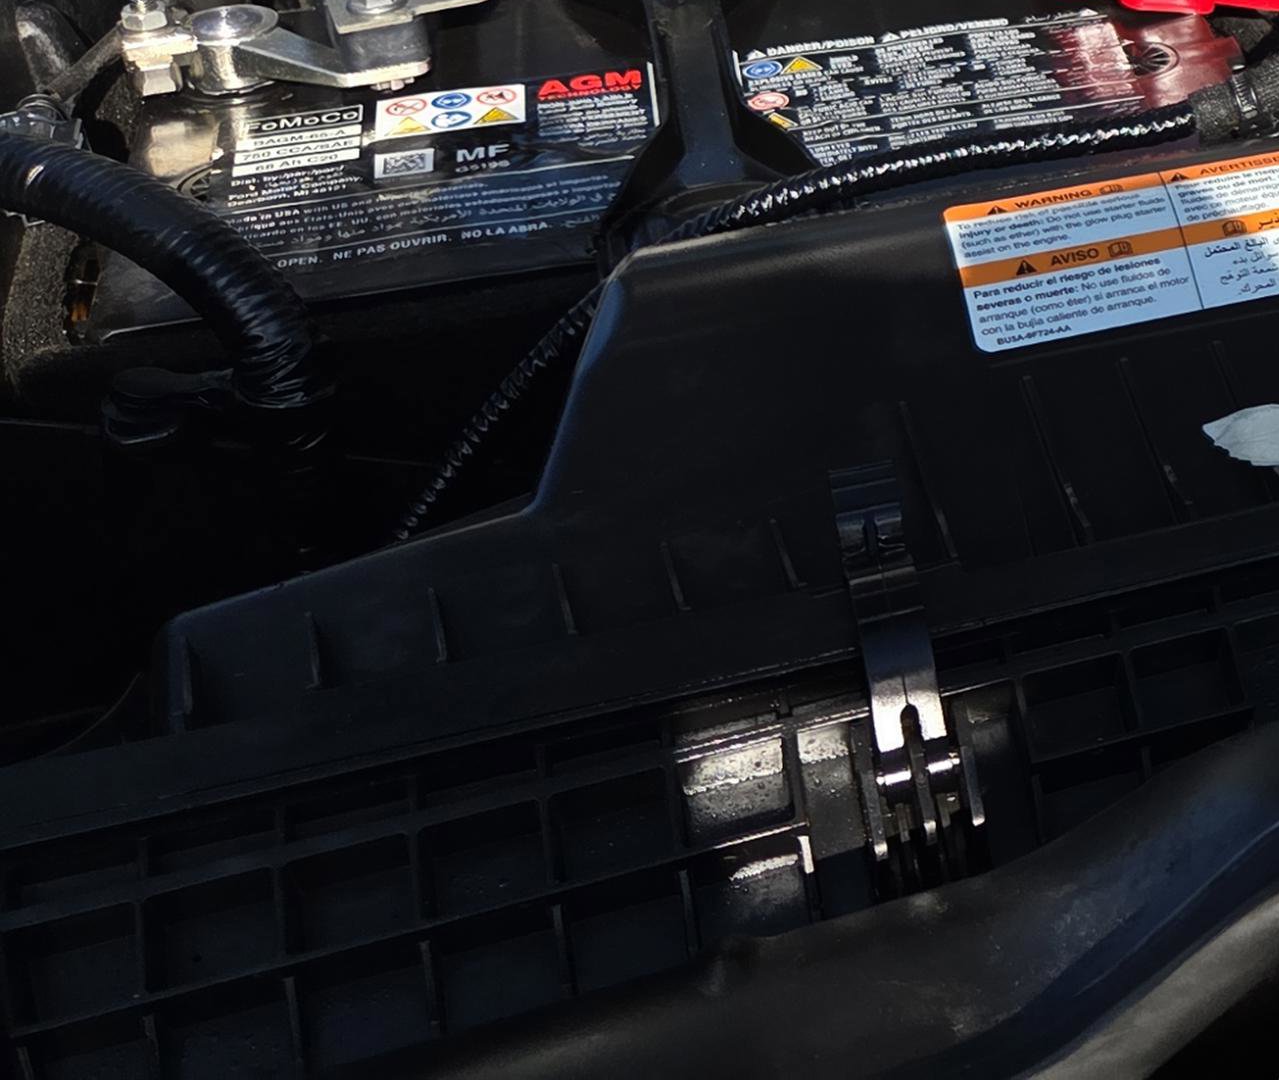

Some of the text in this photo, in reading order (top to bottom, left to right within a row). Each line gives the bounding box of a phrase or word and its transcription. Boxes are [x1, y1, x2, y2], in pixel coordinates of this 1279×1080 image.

[768, 36, 875, 55] DANGER/POISON
[538, 68, 643, 95] AGM
[247, 110, 359, 132] FoMoCo
[455, 143, 510, 162] MF
[1015, 190, 1094, 207] WARNING
[1183, 203, 1209, 213] avec
[1223, 194, 1259, 205] moteur
[1214, 190, 1230, 199] de
[959, 228, 993, 240] injury
[993, 225, 1008, 233] or
[1045, 214, 1062, 224] Do
[1062, 211, 1081, 220] not
[1083, 208, 1102, 217] use
[1103, 202, 1137, 212] starter
[1138, 195, 1166, 207] fluids
[961, 206, 1167, 249] (such as ether) with the glow plug starter
[1185, 213, 1201, 222] de
[332, 249, 353, 262] NE
[356, 244, 386, 257] PAS
[390, 232, 453, 251] OUVRIR.
[461, 227, 481, 241] NO
[485, 224, 505, 237] LA
[508, 218, 554, 233] ABRA.
[963, 233, 1072, 258] assist on the engine.
[1048, 247, 1102, 266] AVISO
[972, 257, 1162, 300] Para reducir el riesgo de lesiones
[975, 266, 1171, 311] severas o muerte: No use fluidos de
[978, 308, 1029, 325] arranque
[1030, 300, 1065, 314] (como
[1065, 293, 1093, 308] éter)
[1105, 285, 1147, 298] arranca
[1146, 280, 1159, 291] el
[1159, 275, 1191, 287] motor
[981, 325, 1003, 337] con
[1002, 321, 1016, 332] la
[1045, 307, 1089, 323] caliente
[1088, 303, 1105, 315] de
[1106, 294, 1158, 312] arranque.
